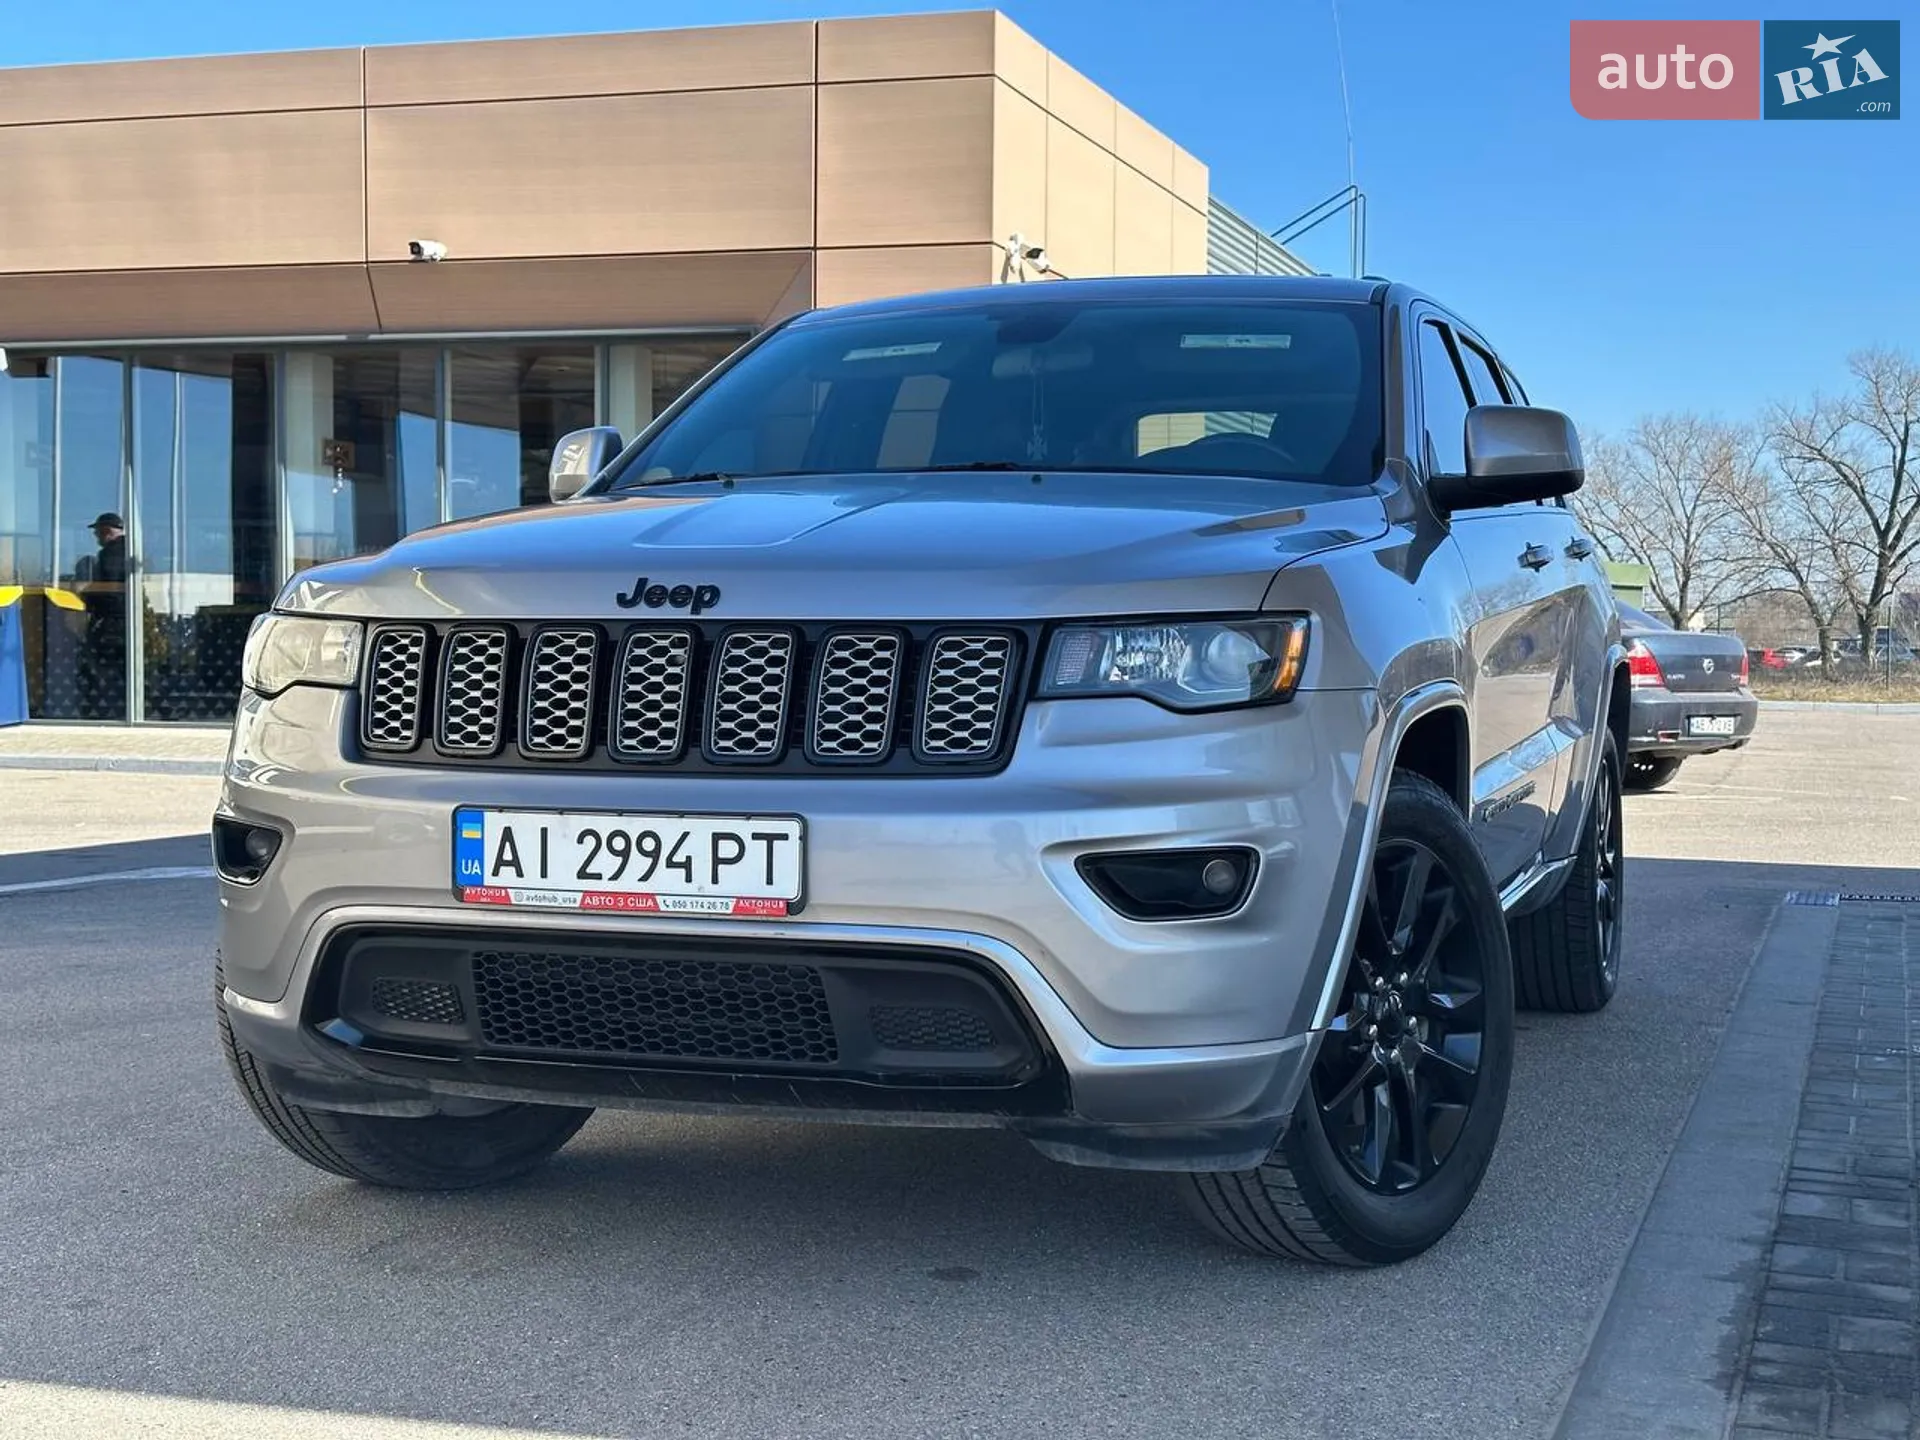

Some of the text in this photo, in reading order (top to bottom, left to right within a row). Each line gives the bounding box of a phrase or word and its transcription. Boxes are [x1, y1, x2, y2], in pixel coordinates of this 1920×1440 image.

[616, 577, 721, 615] Jeep
[462, 859, 481, 875] UA
[491, 826, 789, 886] AI 2994 PT
[584, 895, 612, 906] АВТО
[627, 897, 655, 907] США
